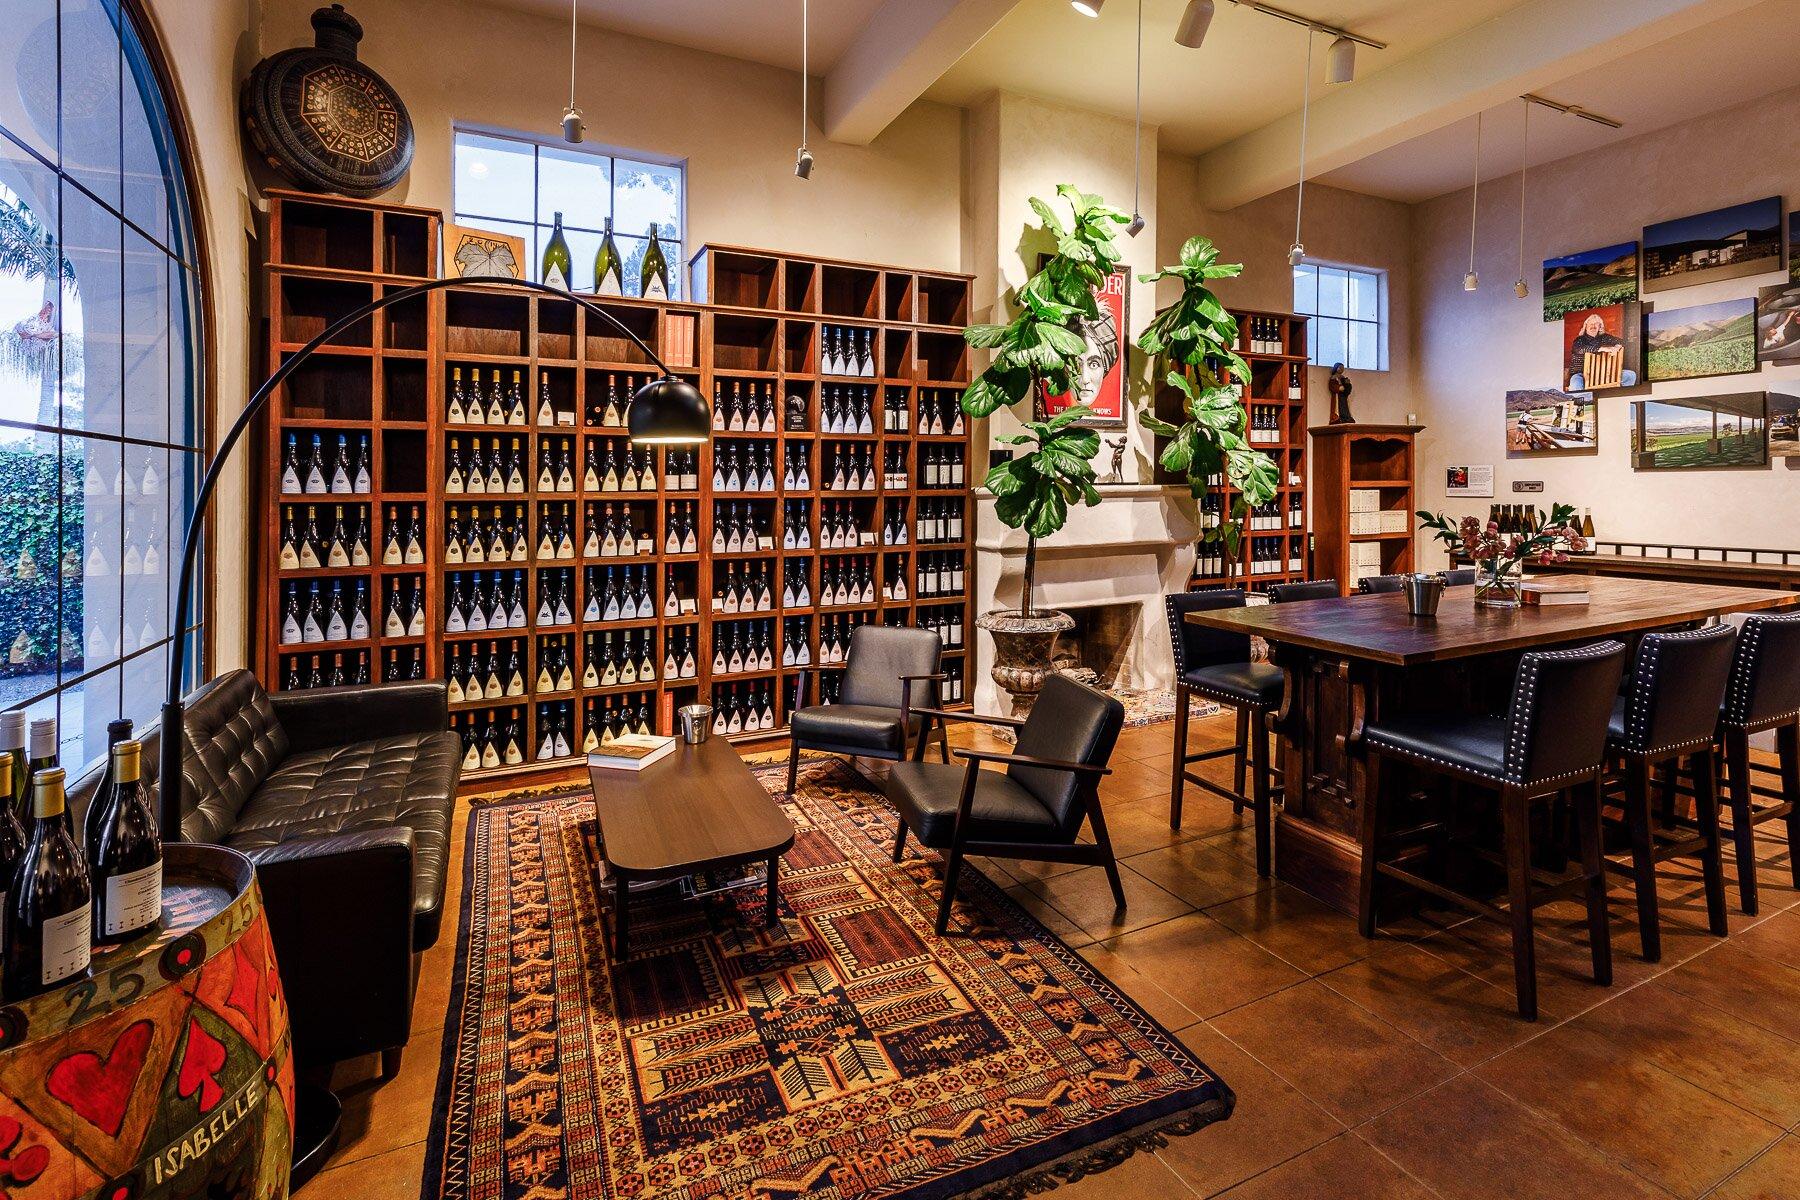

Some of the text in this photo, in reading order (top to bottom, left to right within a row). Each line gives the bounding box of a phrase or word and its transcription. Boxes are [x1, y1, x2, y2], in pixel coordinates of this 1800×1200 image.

[219, 892, 253, 944] 25
[63, 957, 146, 1026] 25
[154, 1081, 258, 1184] ISABELLE
